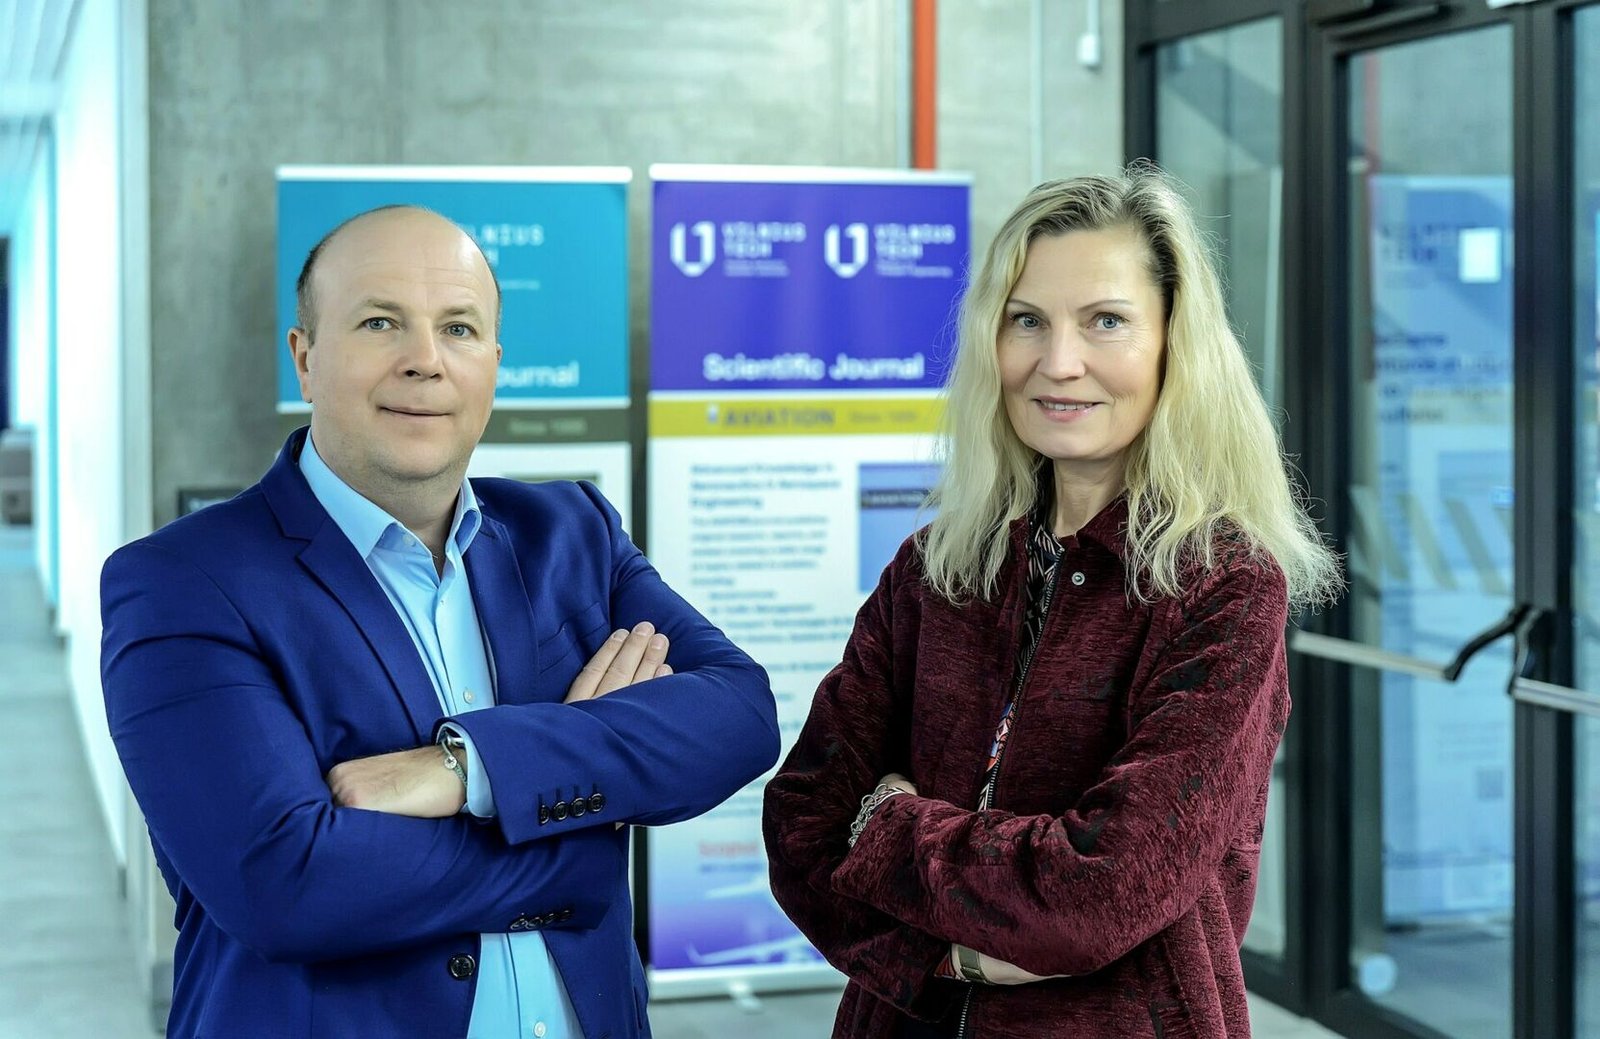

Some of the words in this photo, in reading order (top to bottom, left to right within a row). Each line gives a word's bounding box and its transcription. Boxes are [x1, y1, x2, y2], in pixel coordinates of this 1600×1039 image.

[496, 360, 580, 388] ournal
[704, 353, 824, 381] Scientific
[829, 352, 925, 381] Journal
